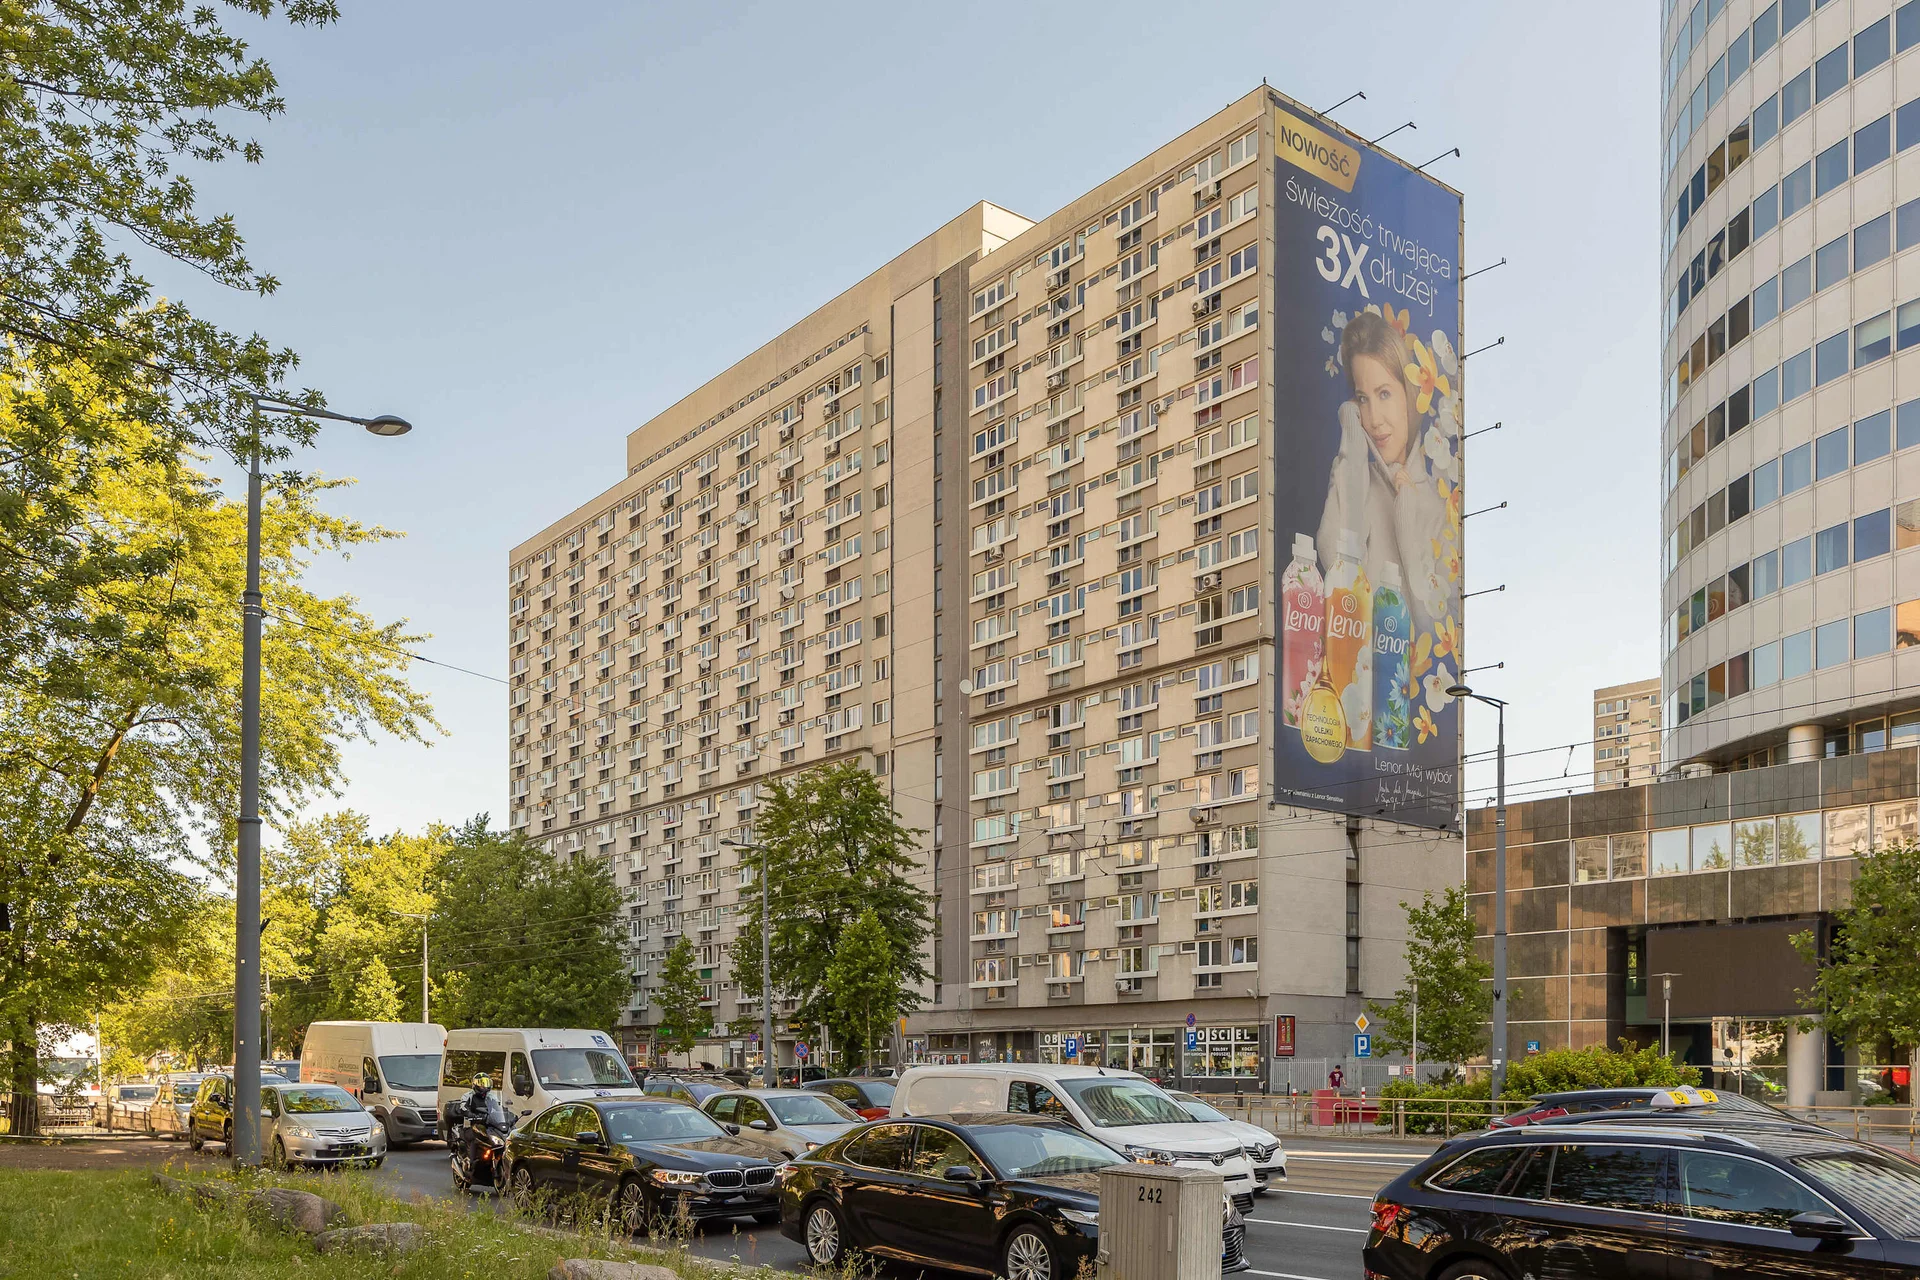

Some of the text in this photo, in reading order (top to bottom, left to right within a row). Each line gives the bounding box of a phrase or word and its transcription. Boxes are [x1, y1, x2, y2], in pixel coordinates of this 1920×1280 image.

[1281, 125, 1350, 177] NOWOŚĆ
[1286, 176, 1451, 280] świeżość trwająca
[1315, 225, 1370, 299] 3X
[1284, 601, 1325, 632] Lenor
[1327, 604, 1371, 639] Lenor
[1373, 625, 1409, 654] Lenor
[1305, 734, 1343, 749] ZAPACHOWEGO
[1374, 756, 1453, 784] Lenor. Mój wybór
[1068, 1040, 1075, 1052] P
[1189, 1033, 1195, 1045] P
[1197, 1028, 1250, 1041] OŚCIEL
[1357, 1036, 1368, 1055] P
[1138, 1185, 1162, 1204] 242
